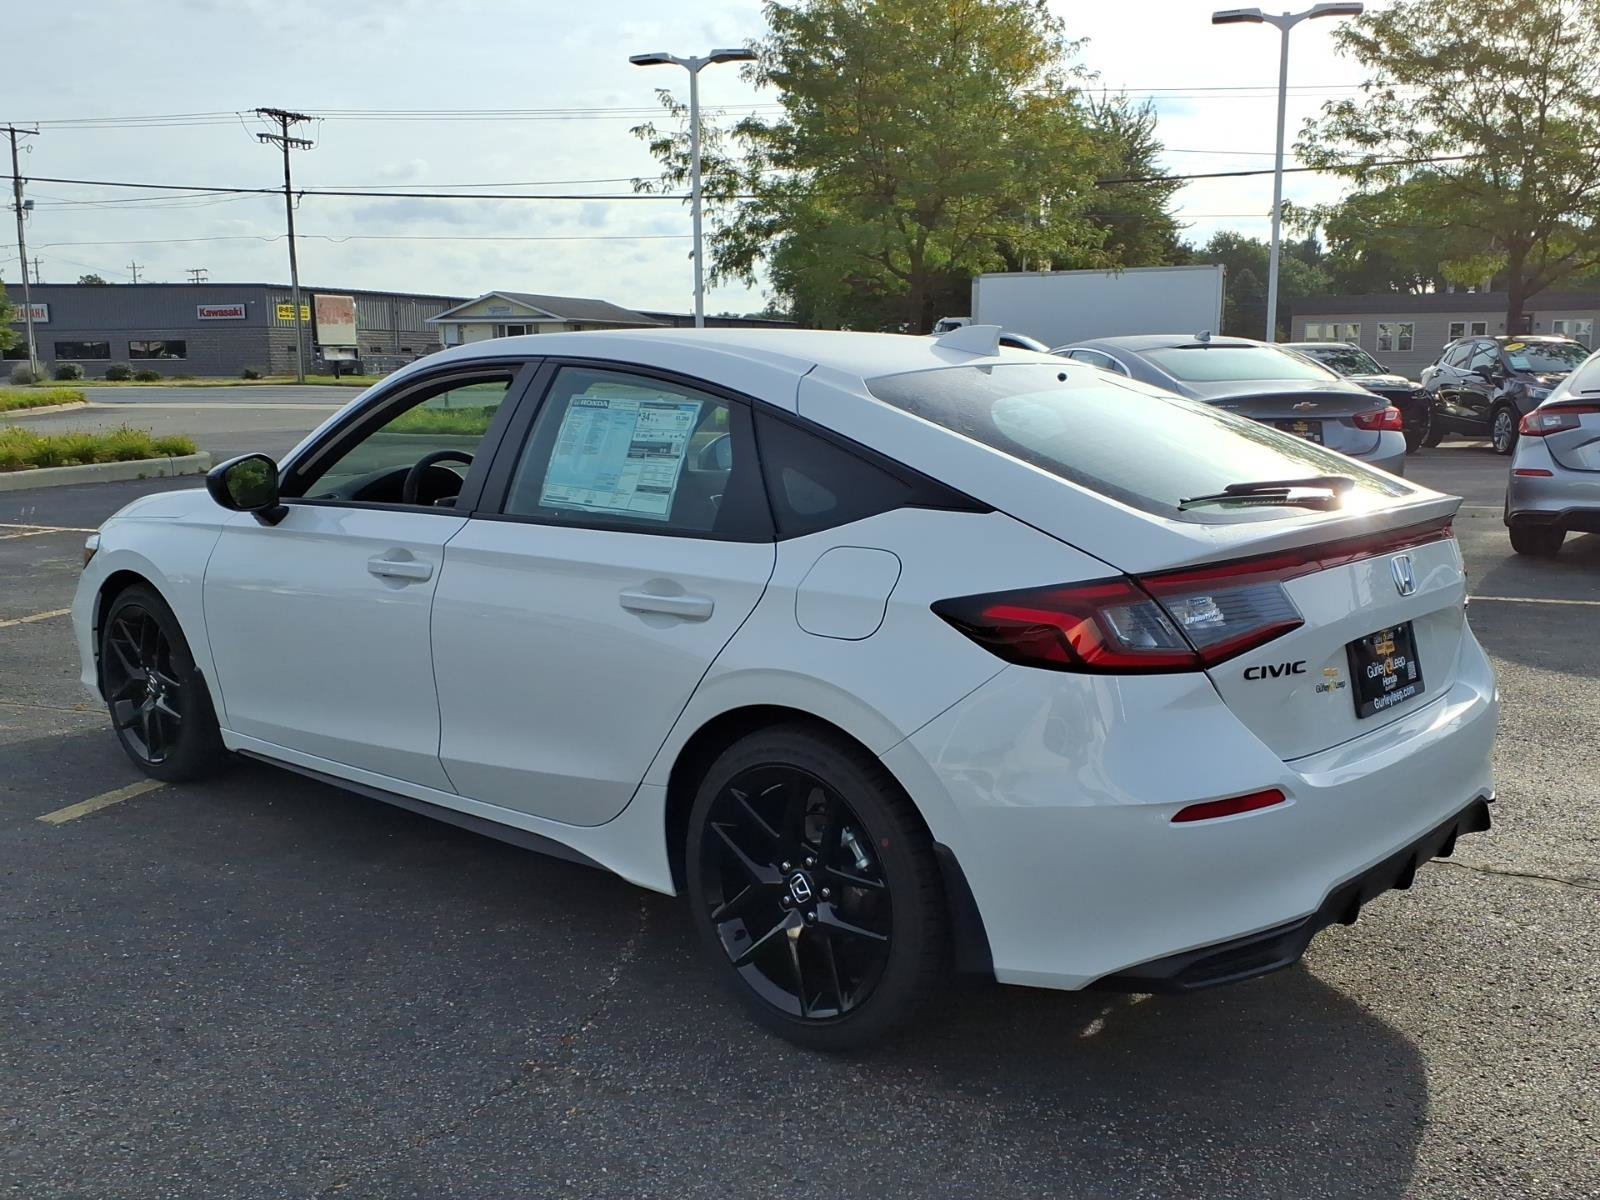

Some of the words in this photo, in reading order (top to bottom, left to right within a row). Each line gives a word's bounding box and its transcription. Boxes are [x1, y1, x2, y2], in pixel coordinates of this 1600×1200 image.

[15, 307, 45, 317] YAAHA
[198, 305, 243, 317] Kawasaki
[581, 399, 609, 408] HONDA
[1243, 660, 1307, 680] CIVIC
[1382, 675, 1398, 687] Honda
